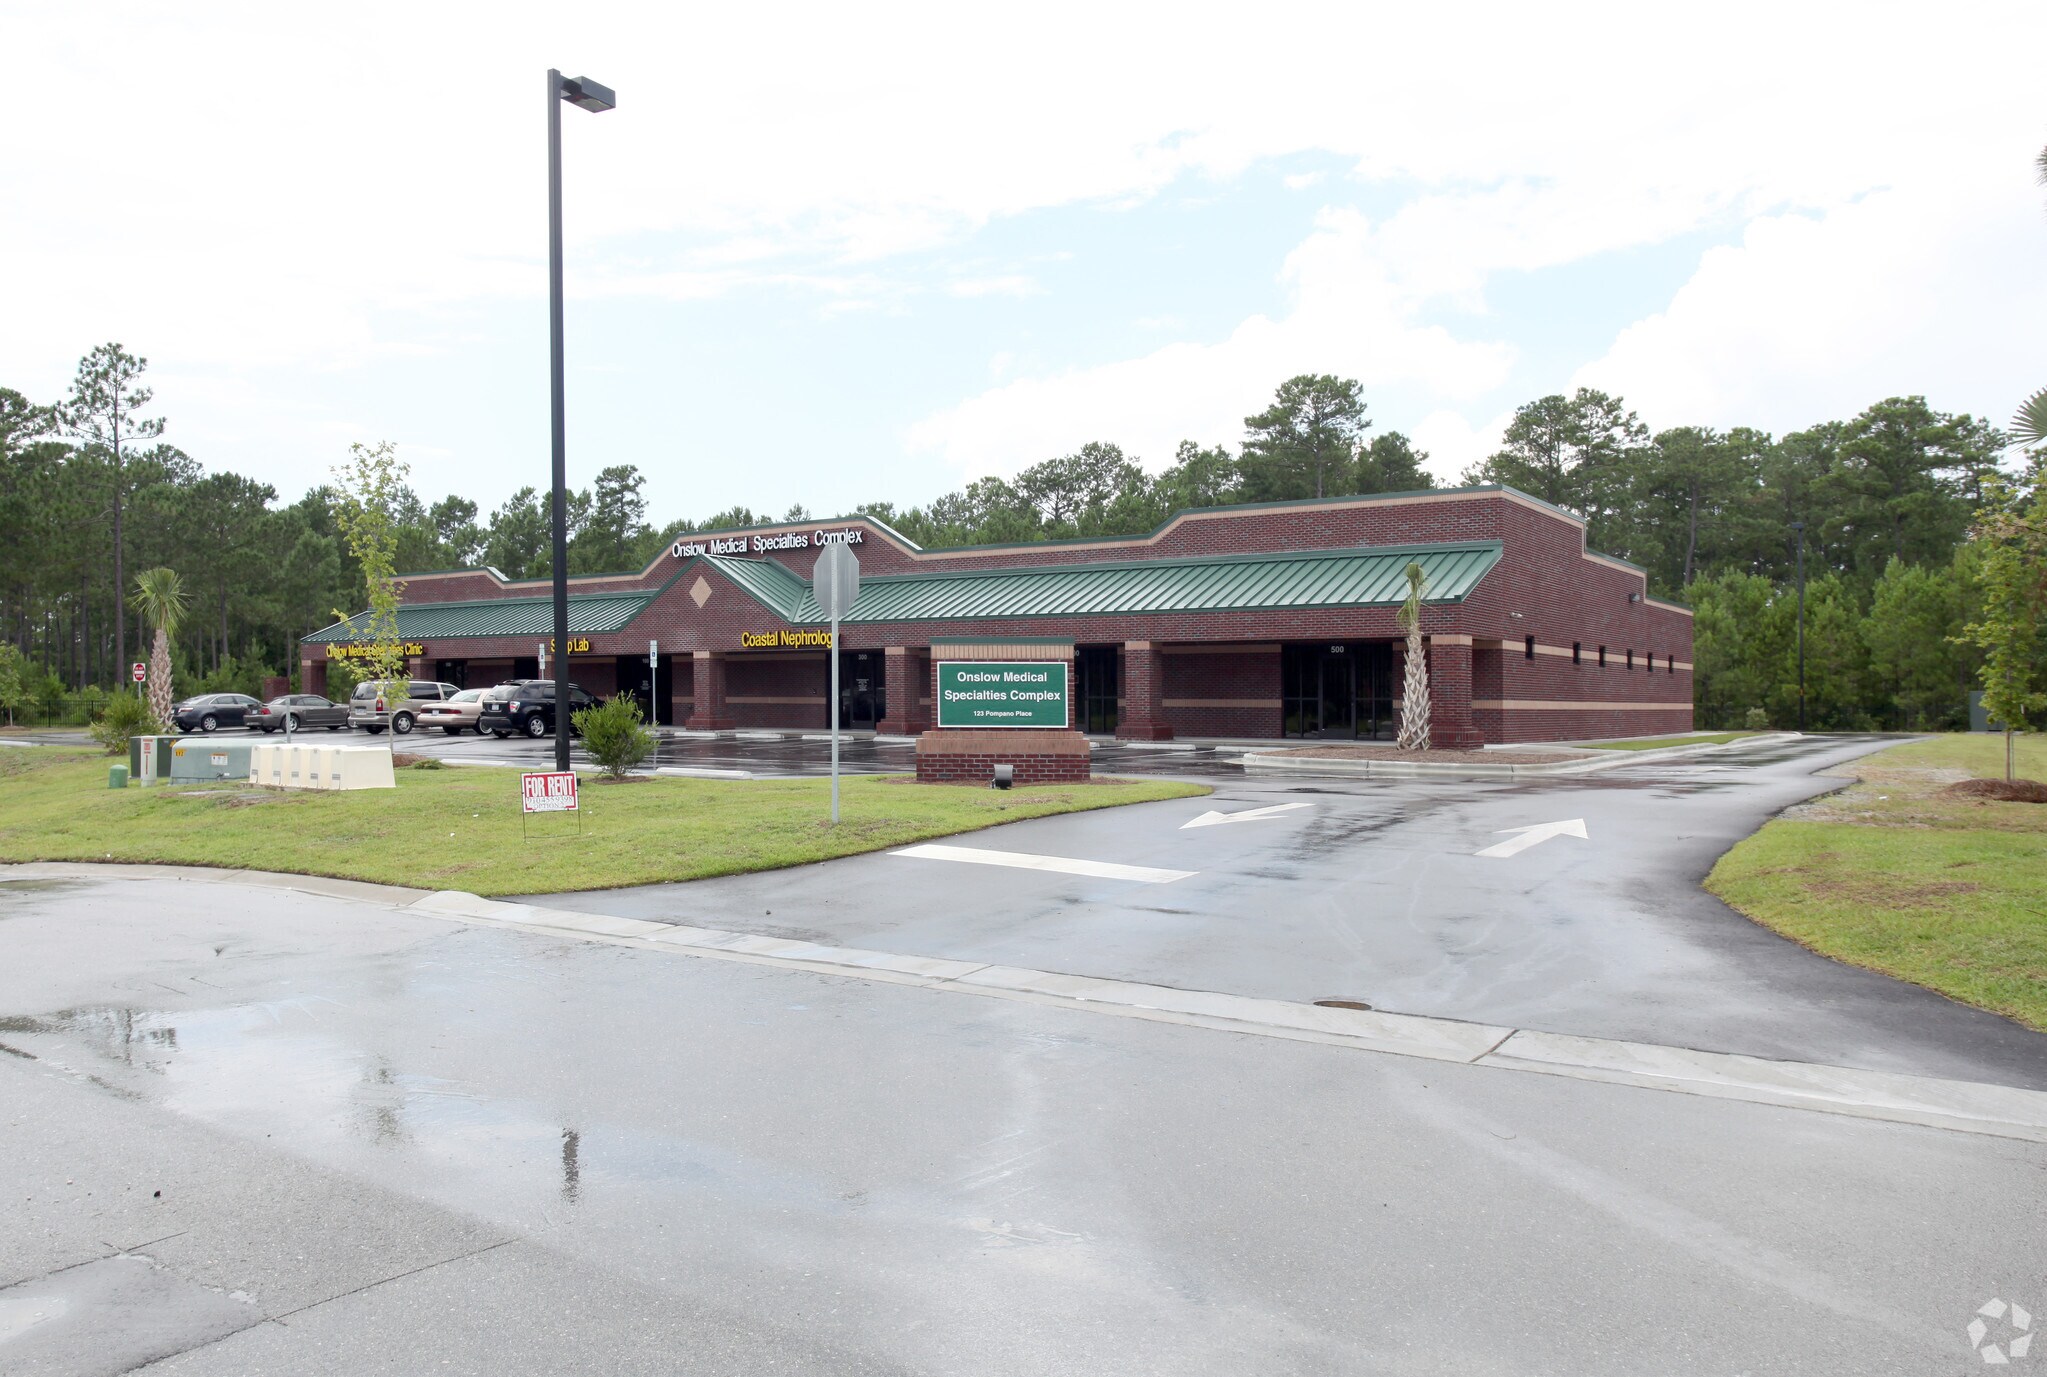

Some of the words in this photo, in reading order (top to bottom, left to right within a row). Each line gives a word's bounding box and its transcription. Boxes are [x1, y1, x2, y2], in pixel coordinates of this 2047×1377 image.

[672, 541, 707, 558] Onslow
[710, 537, 748, 555] Medical
[753, 532, 808, 553] Specialties
[814, 528, 863, 546] Complex
[573, 637, 590, 652] Lab
[741, 631, 778, 647] Coastal
[781, 629, 838, 649] Nephrolog
[404, 642, 423, 656] Clinic
[1330, 645, 1345, 653] 500
[957, 671, 1001, 682] Onslow
[1003, 671, 1048, 682] Medical
[944, 689, 1007, 702] Specialties
[1010, 690, 1061, 702] Complex
[985, 710, 1014, 718] Pompano
[525, 776, 546, 798] FOR
[547, 775, 573, 796] RENT
